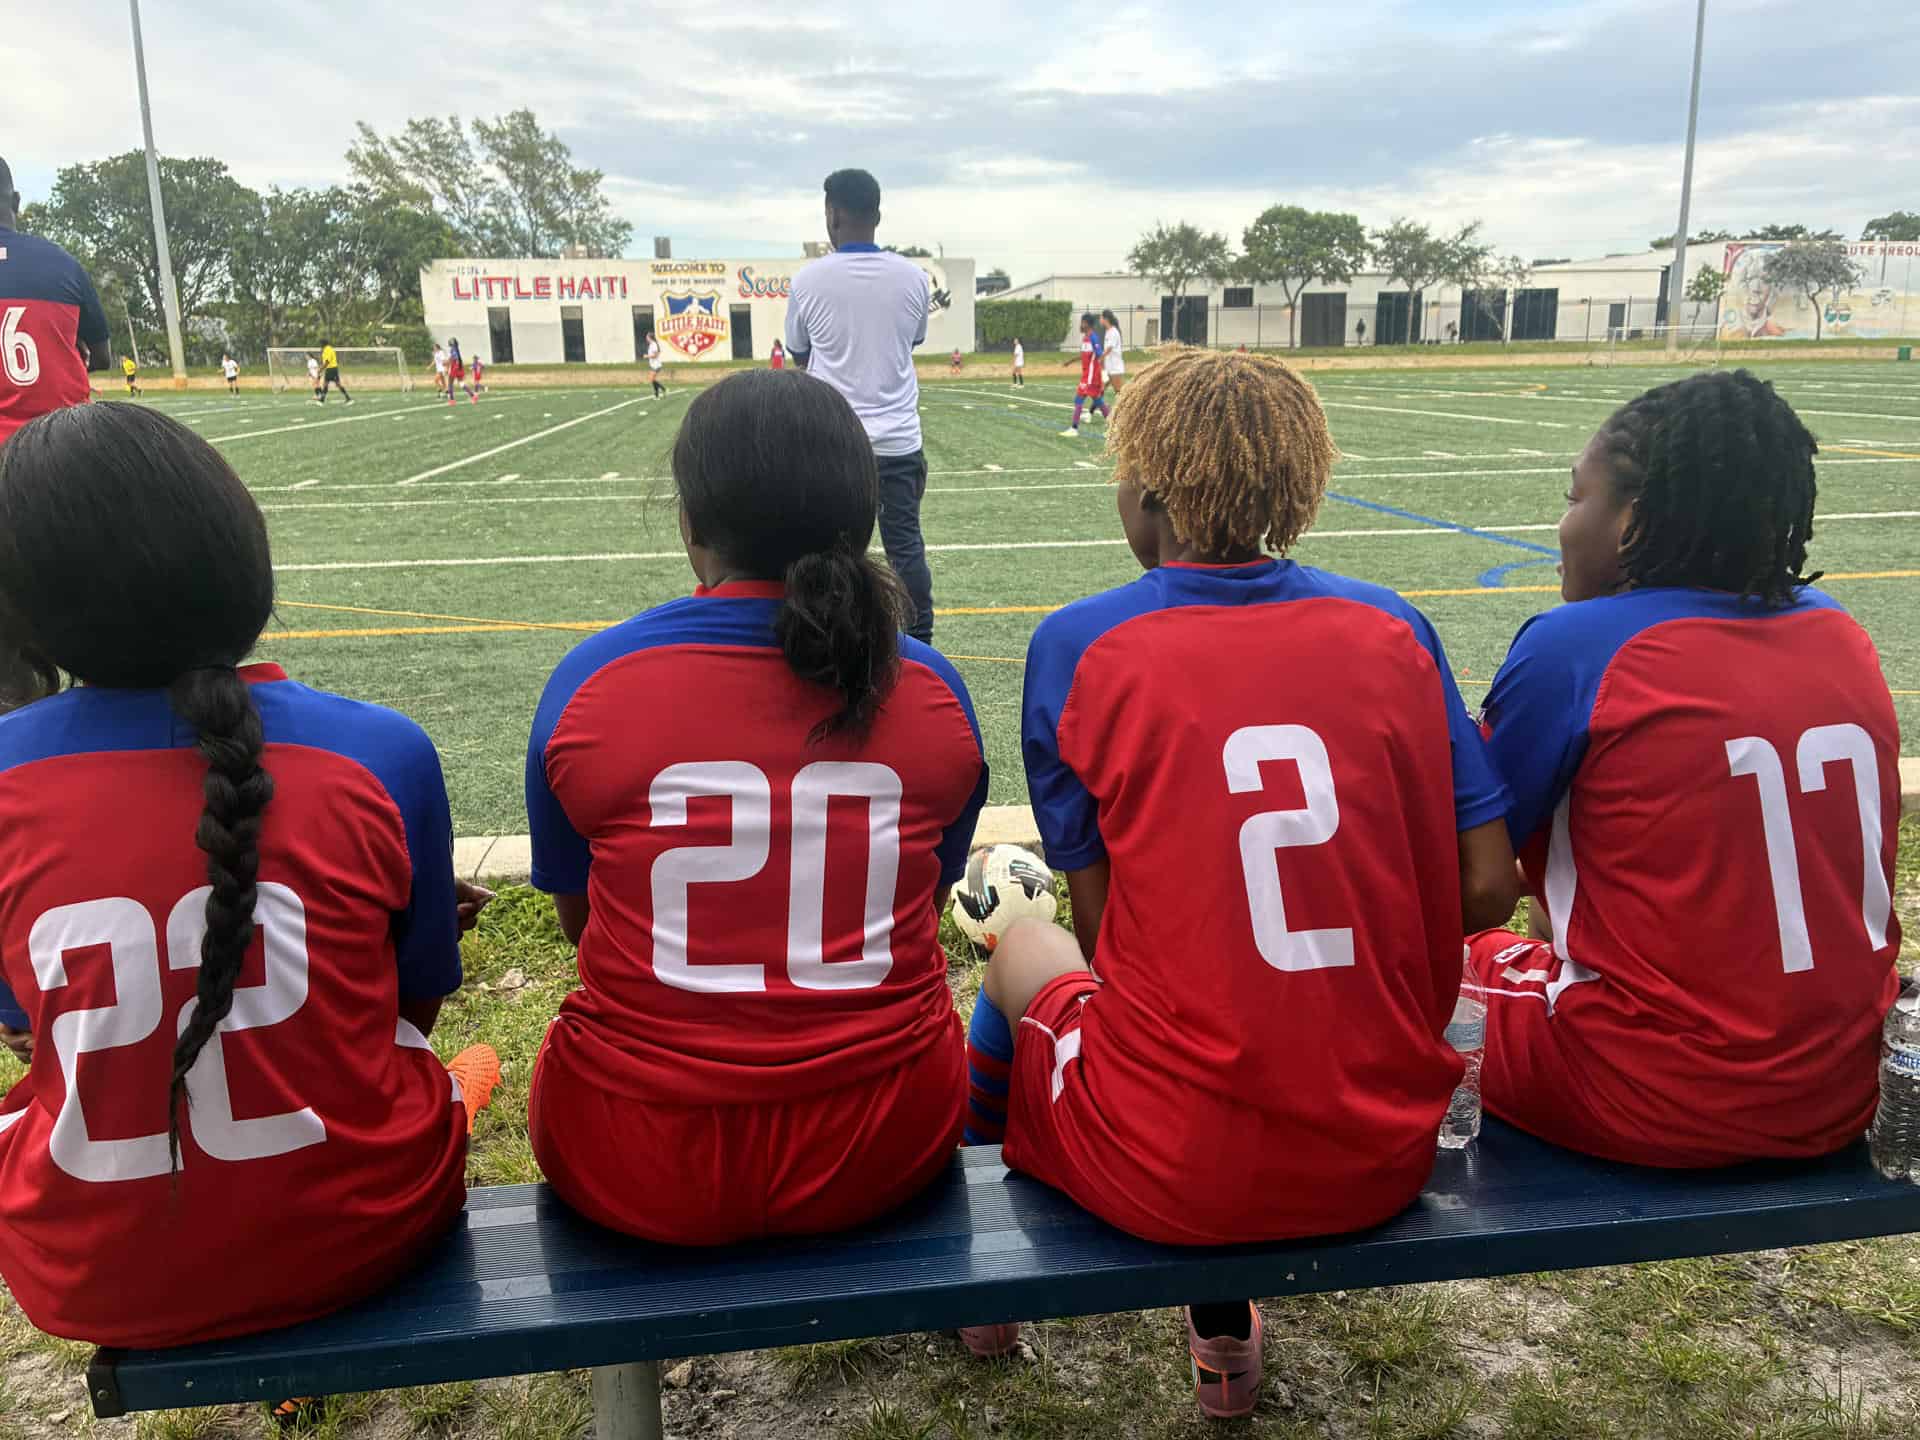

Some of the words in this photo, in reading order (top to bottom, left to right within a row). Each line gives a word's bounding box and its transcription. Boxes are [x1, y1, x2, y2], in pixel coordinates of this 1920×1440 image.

[453, 277, 552, 299] LITTLE
[558, 276, 628, 299] HAITI
[651, 263, 706, 274] WELCOME
[708, 263, 726, 274] TO
[736, 265, 790, 298] Socc
[1, 307, 40, 386] 6
[662, 317, 693, 332] LITTLE
[696, 316, 724, 331] HAITI
[648, 760, 904, 994] 20
[1222, 724, 1357, 973] 2
[1724, 722, 1891, 975] 17
[28, 881, 327, 1182] 22
